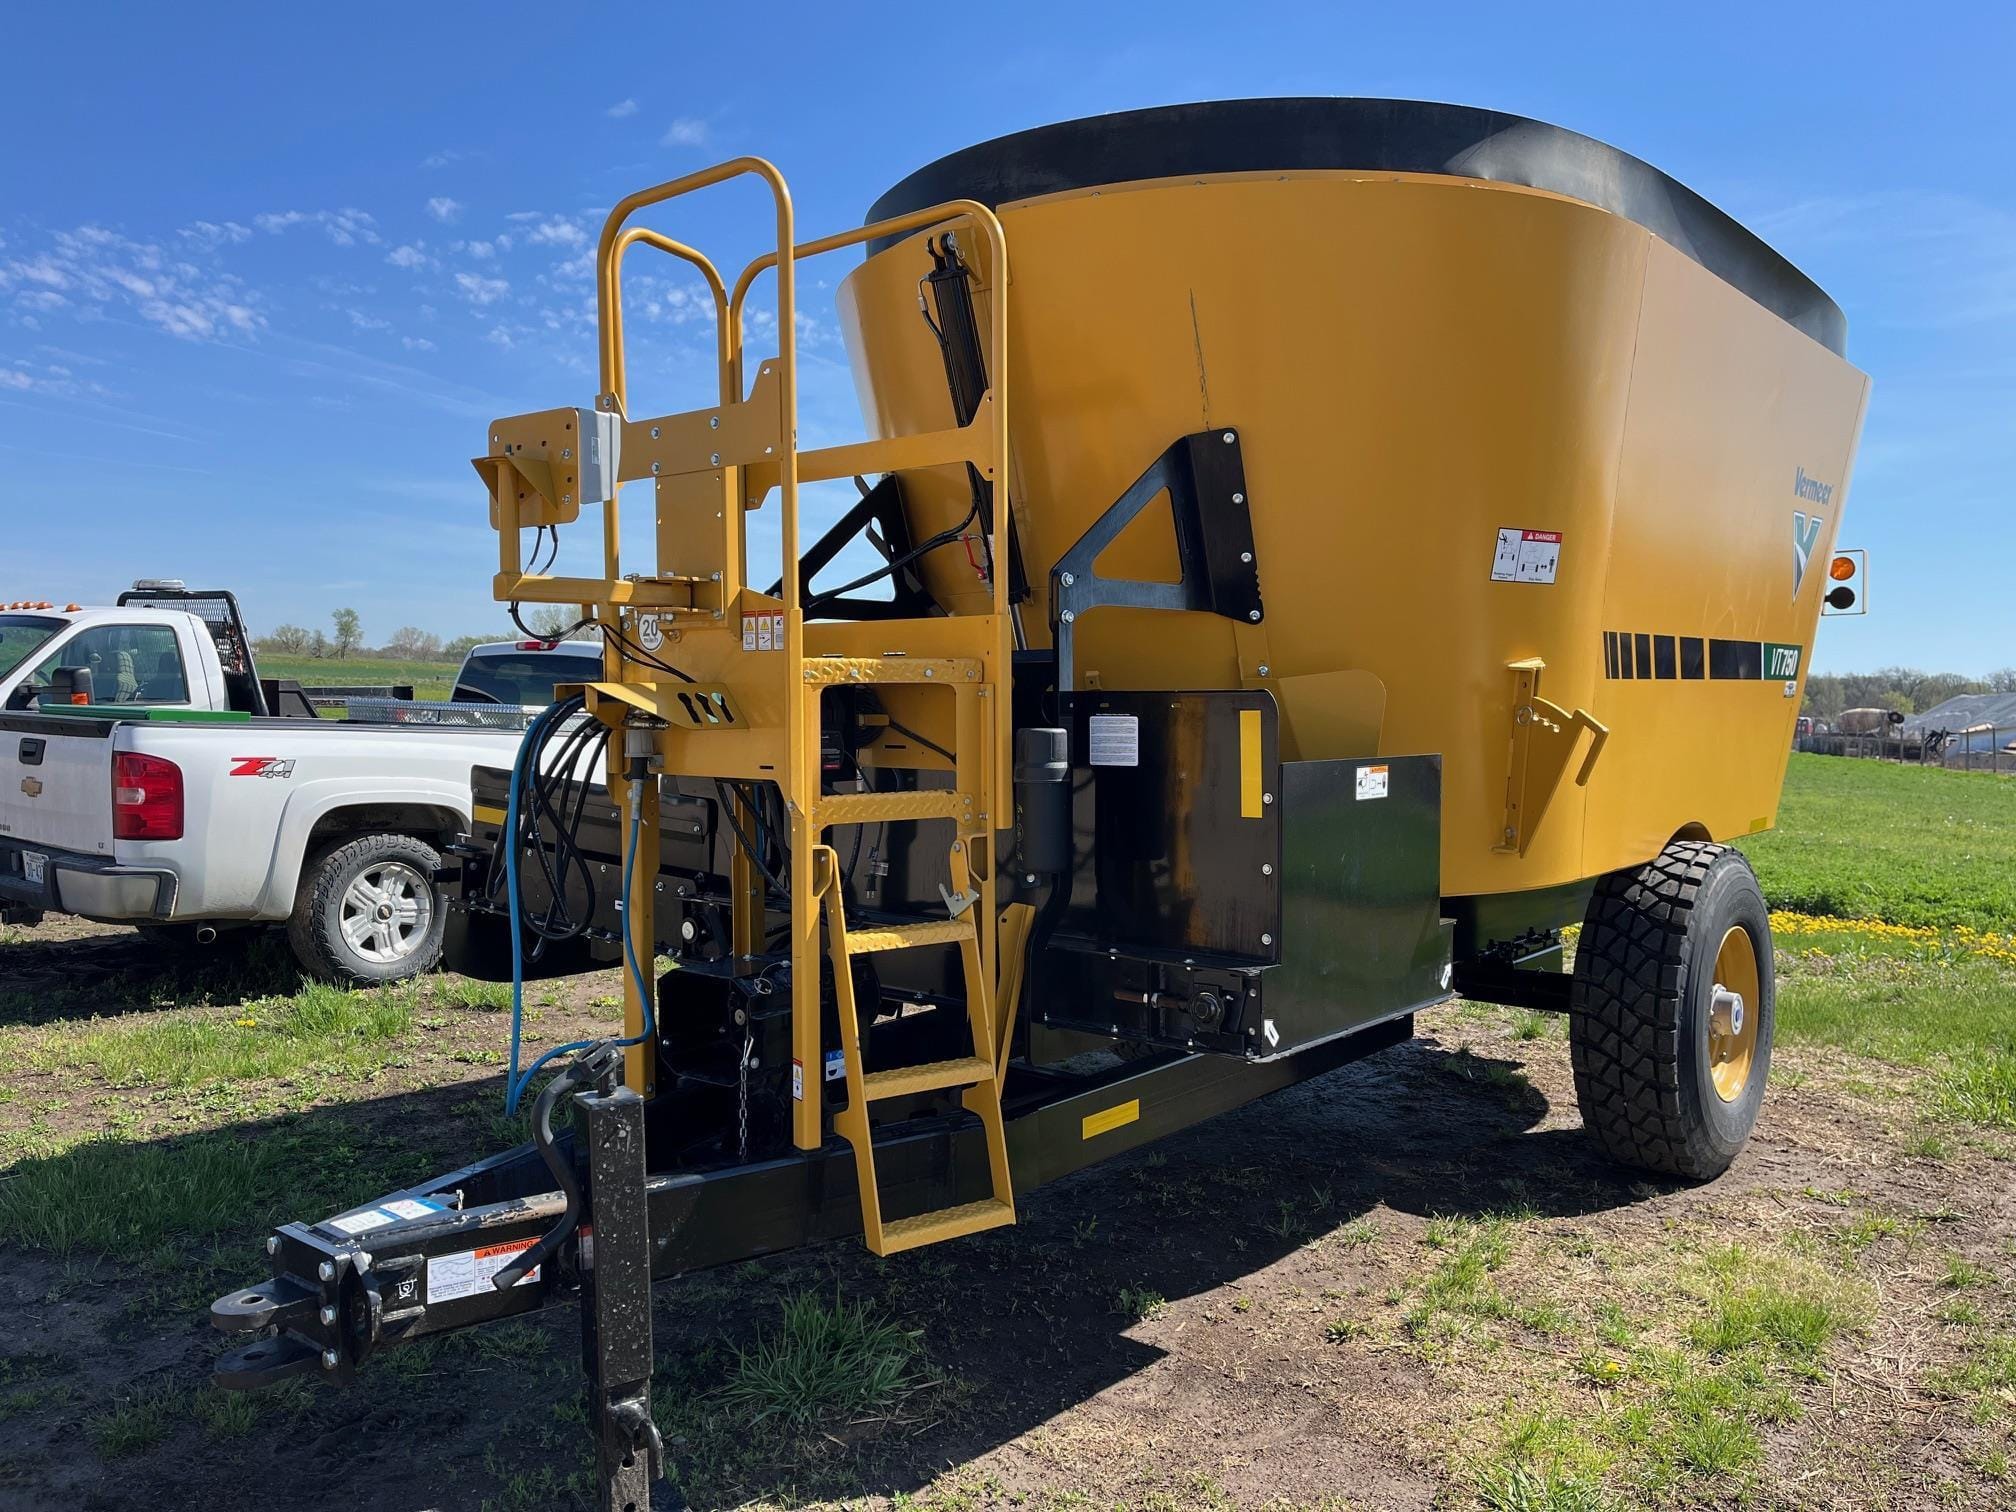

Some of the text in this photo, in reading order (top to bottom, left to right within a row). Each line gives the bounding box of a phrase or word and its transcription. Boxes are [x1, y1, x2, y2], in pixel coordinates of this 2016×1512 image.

[1795, 467, 1832, 505] Vermeer
[1535, 533, 1556, 541] DANGER
[642, 619, 658, 637] 20
[1770, 647, 1799, 676] VT750
[229, 756, 297, 777] Z71
[492, 1240, 534, 1254] WARNING
